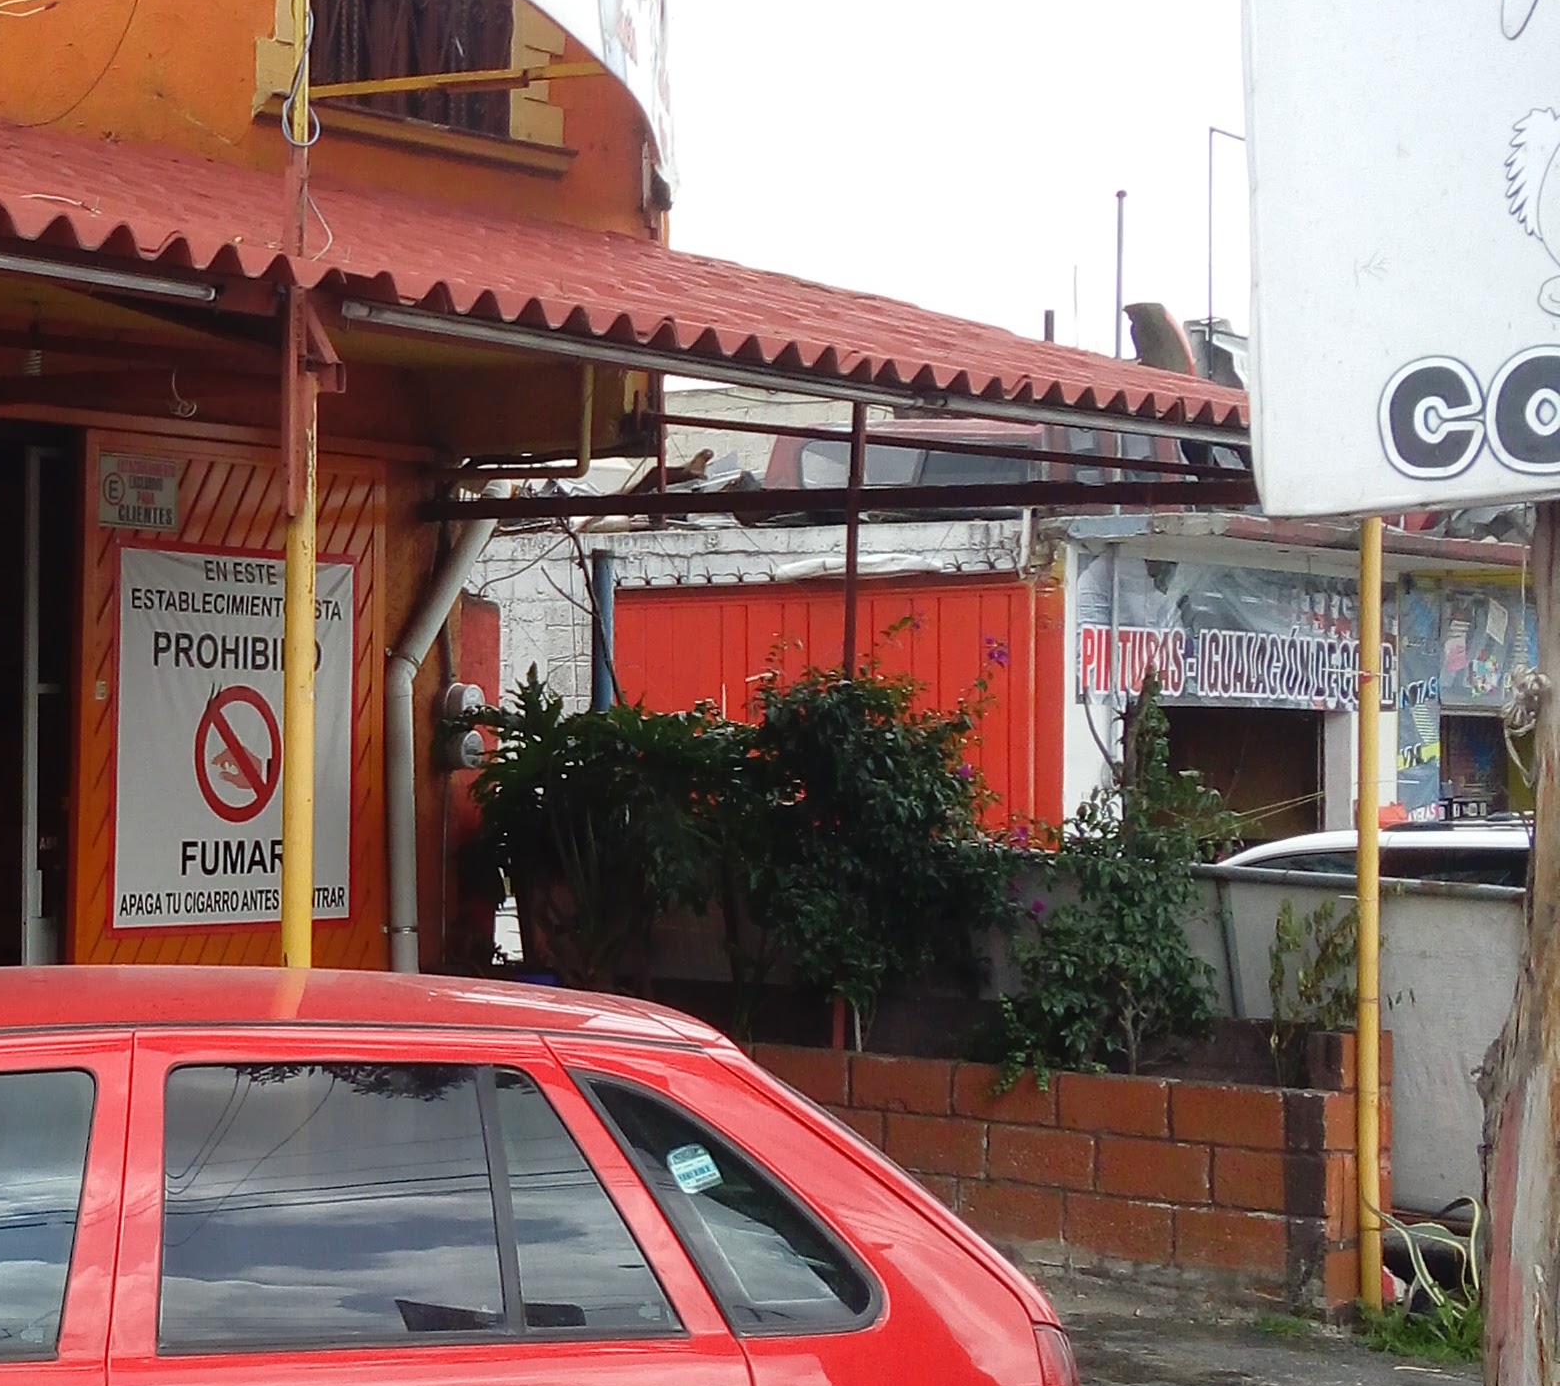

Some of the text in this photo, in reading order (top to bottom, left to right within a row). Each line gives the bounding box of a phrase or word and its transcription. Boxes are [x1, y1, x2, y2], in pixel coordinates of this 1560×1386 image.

[1384, 351, 1560, 472] CO
[118, 503, 173, 525] CLIENTES
[204, 560, 278, 586] EN ESTE
[132, 588, 342, 621] ESTABLECIMIENT STA
[1081, 624, 1185, 697] PINTURAS
[1198, 626, 1312, 701] IGUALACIÓN
[1313, 639, 1337, 707] DE
[1338, 641, 1394, 705] COR
[180, 840, 283, 876] FUMAR
[120, 886, 345, 917] APAGA TU CIGARRO ANTES TRAR
